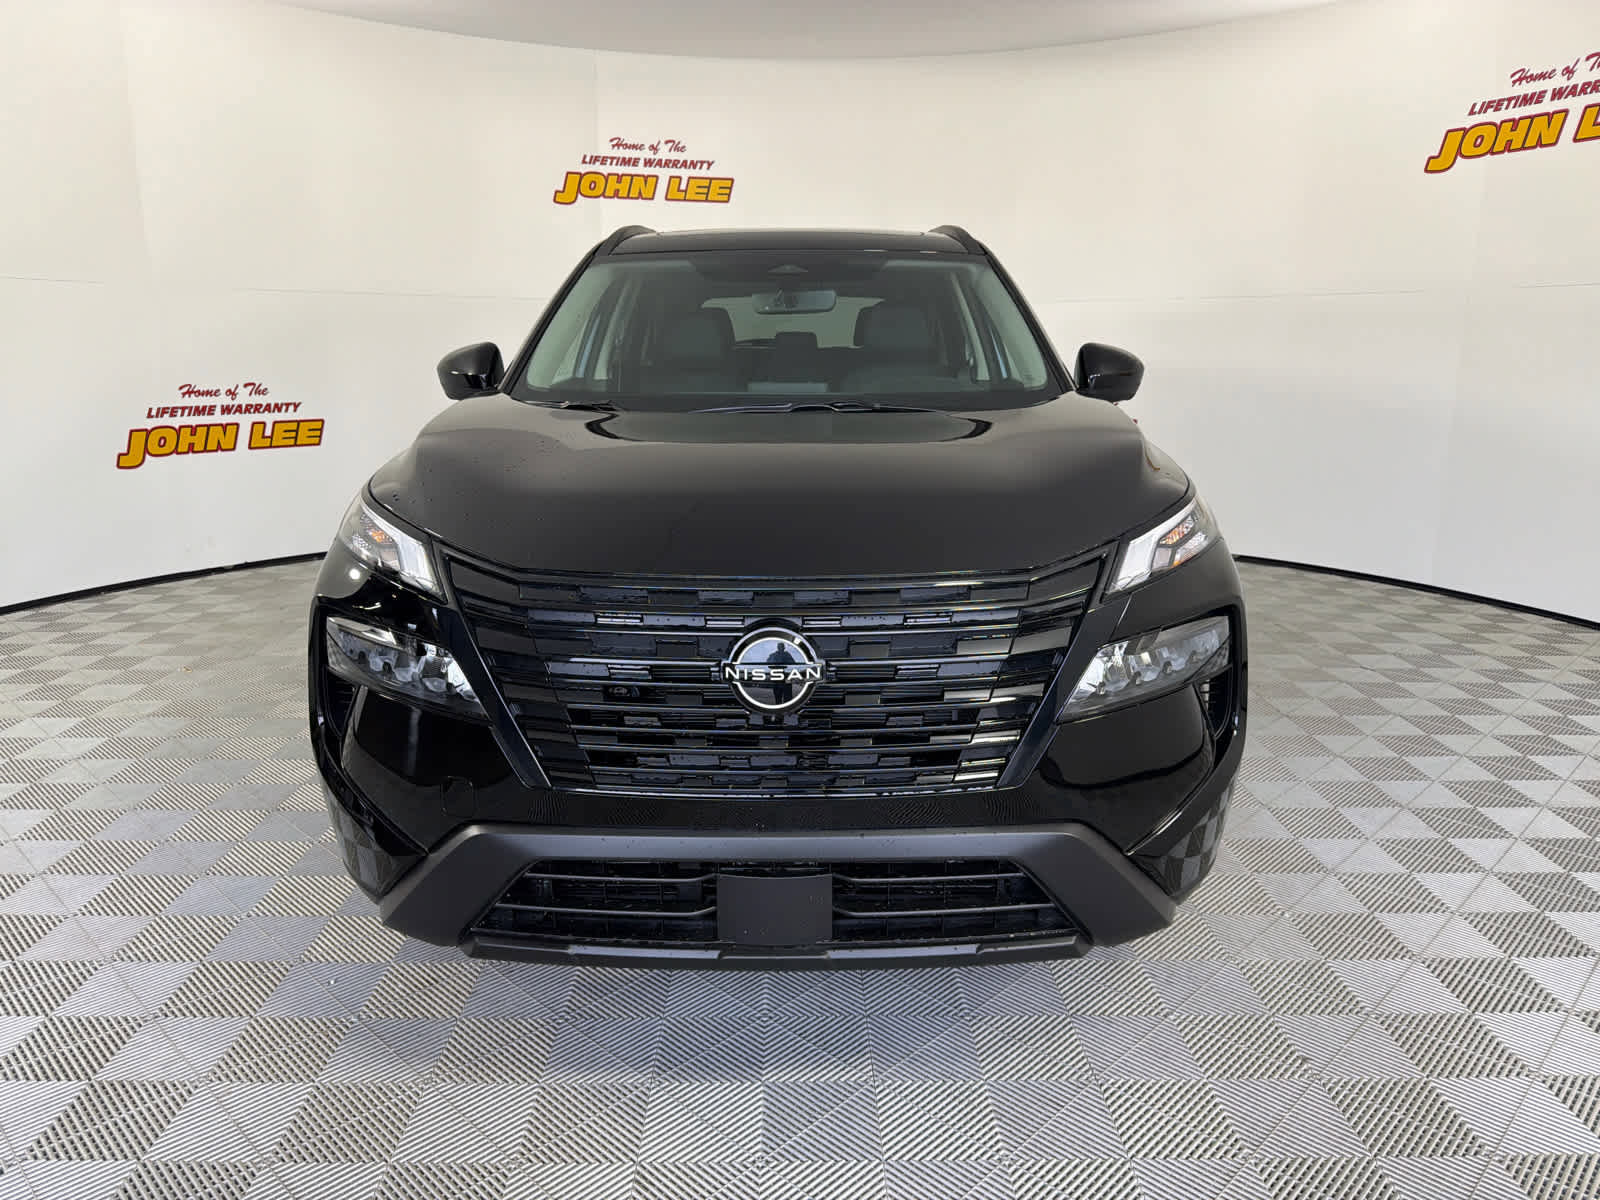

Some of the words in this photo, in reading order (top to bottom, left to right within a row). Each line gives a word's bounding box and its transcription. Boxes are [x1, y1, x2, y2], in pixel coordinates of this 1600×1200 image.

[1510, 68, 1557, 87] Home
[1561, 58, 1580, 81] of
[1585, 52, 1600, 72] T
[1468, 89, 1548, 116] LIFETIME
[609, 137, 645, 151] Home
[649, 140, 660, 155] of
[664, 139, 687, 153] The
[1424, 108, 1569, 173] JOHN
[581, 154, 641, 168] LIFETIME
[643, 158, 715, 171] WARRANTY
[553, 171, 659, 205] JOHN
[665, 176, 734, 203] LEE
[178, 384, 221, 399] Home
[225, 384, 239, 400] of
[243, 382, 269, 396] The
[146, 404, 216, 419] LIFETIME
[220, 401, 302, 416] WARRANTY
[116, 423, 239, 469] JOHN
[248, 419, 324, 450] LEE
[725, 666, 821, 681] NISSAN
